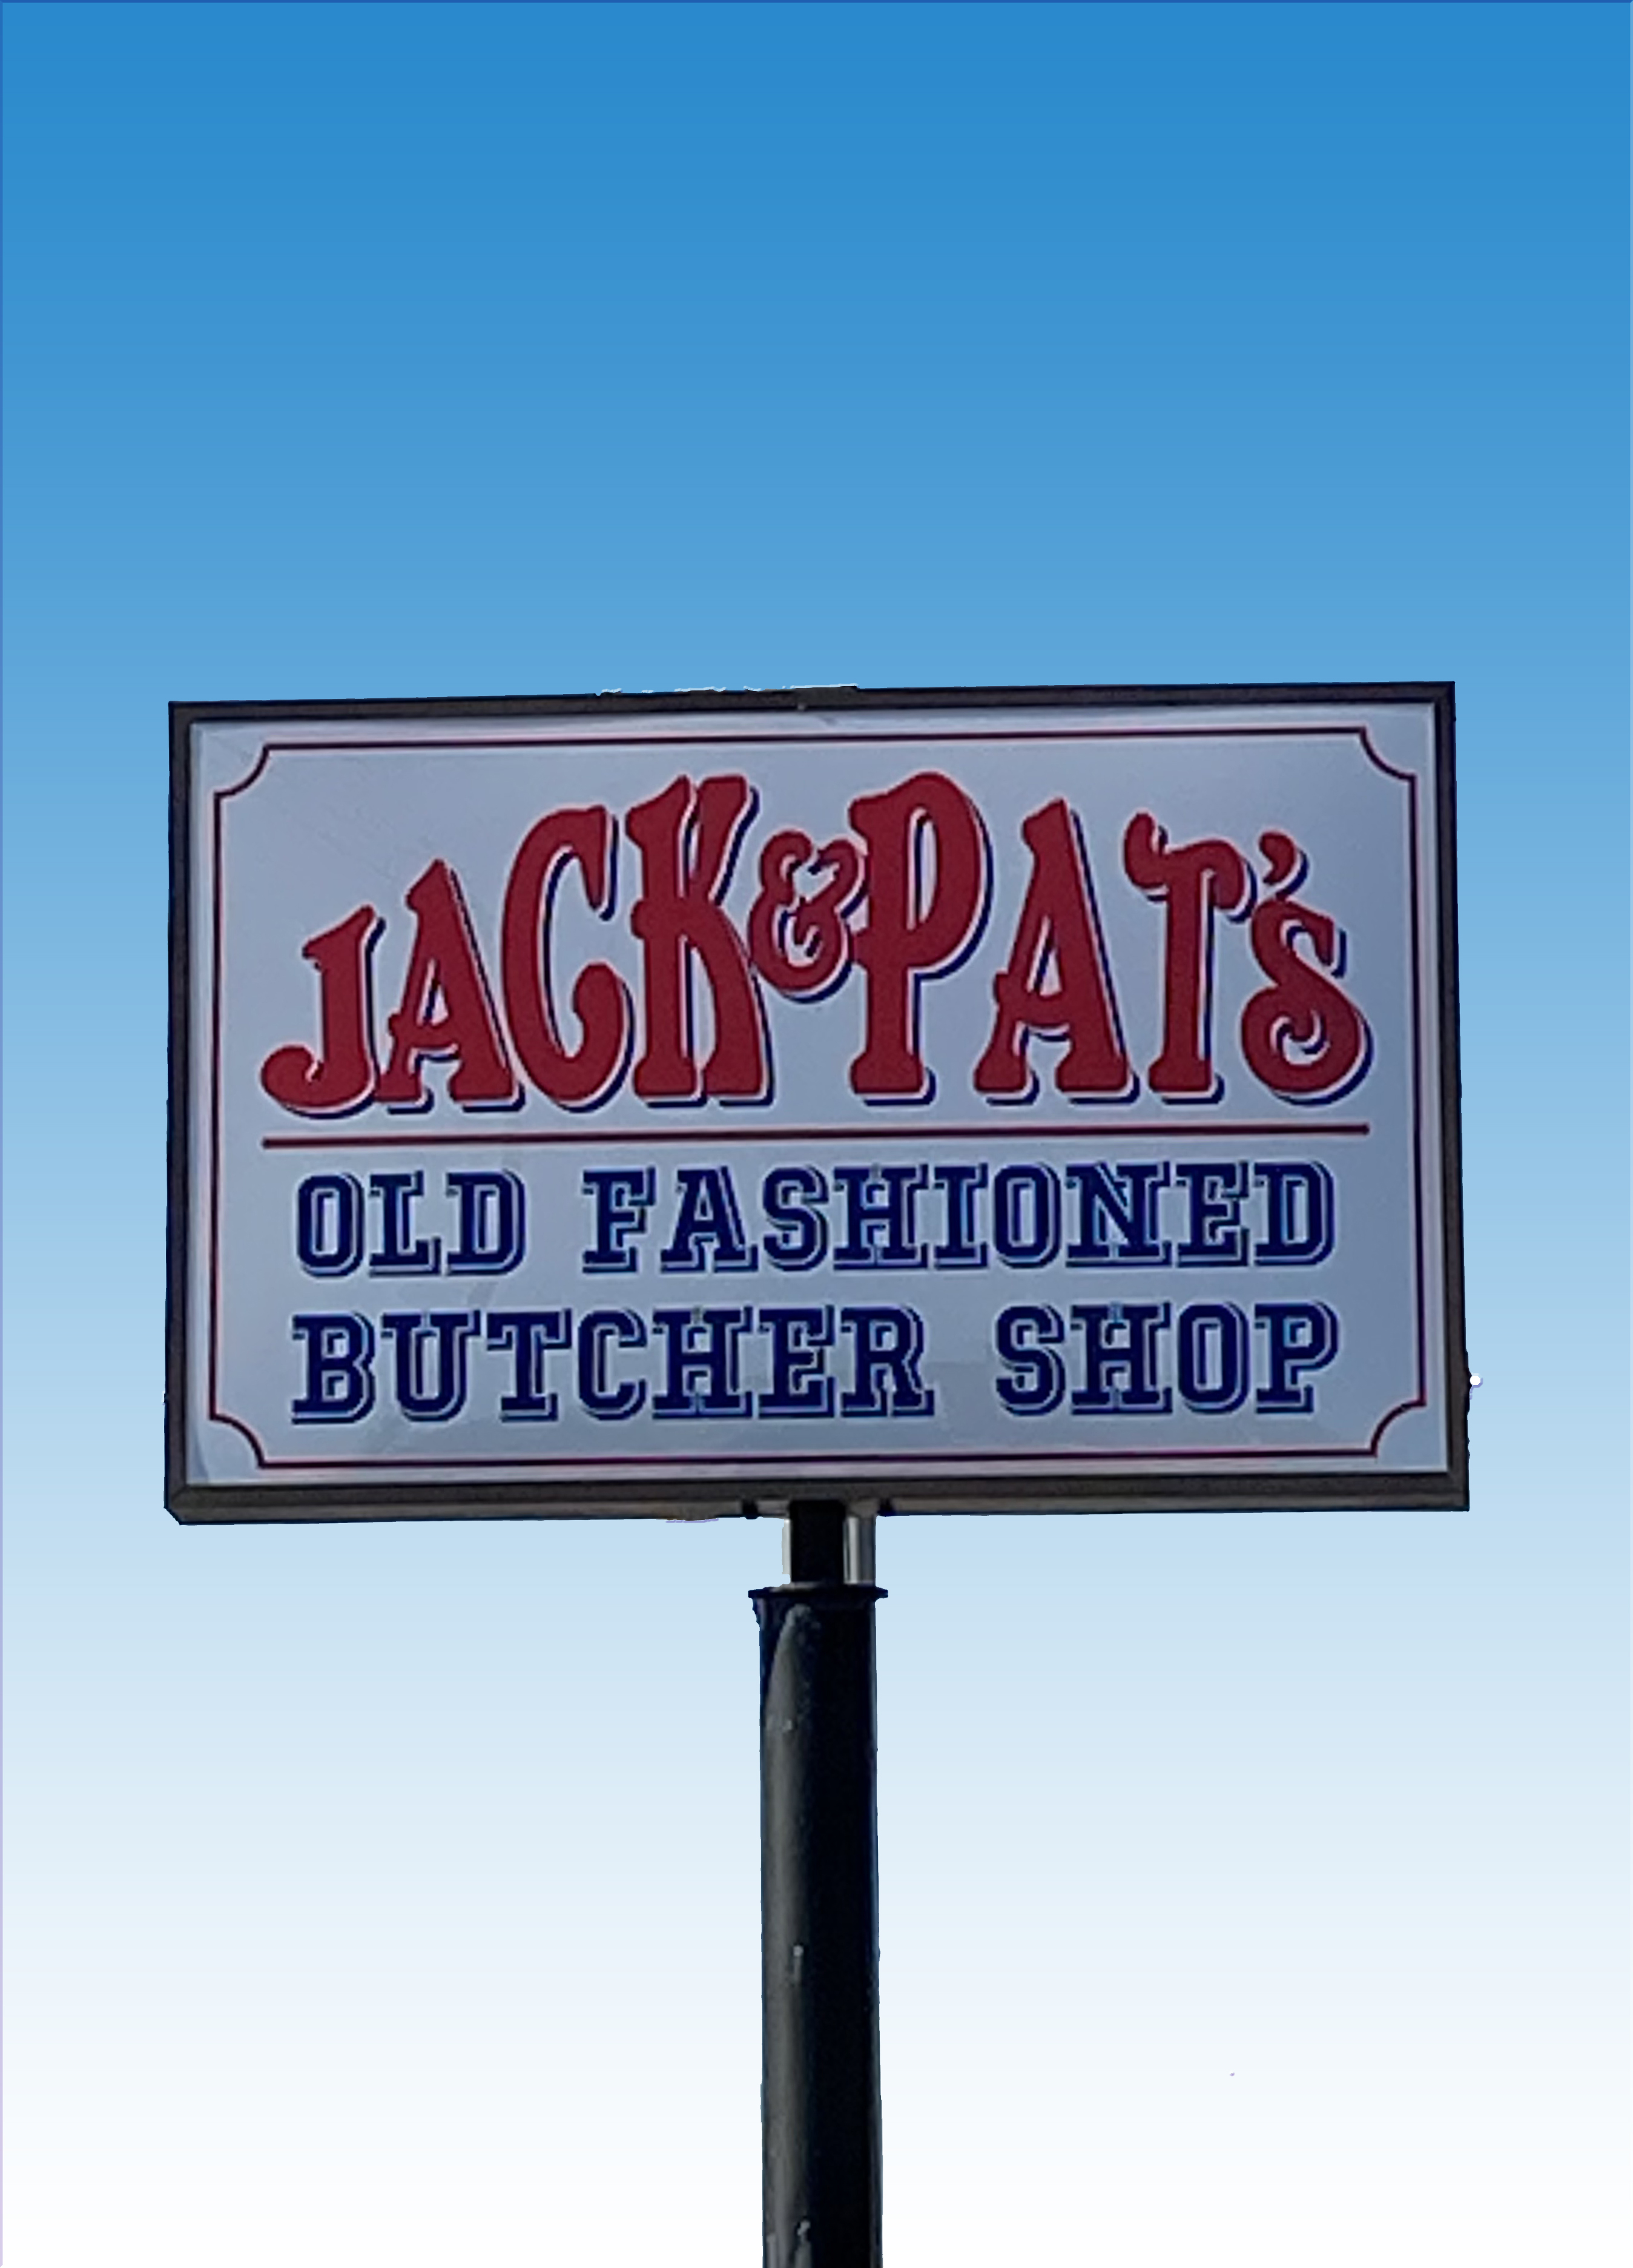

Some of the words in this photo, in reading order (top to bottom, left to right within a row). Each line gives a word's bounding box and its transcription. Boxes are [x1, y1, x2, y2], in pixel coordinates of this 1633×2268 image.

[297, 1169, 526, 1277] OLD
[582, 1161, 1335, 1274] FASHIONED
[292, 1304, 934, 1424] BUTCHER
[995, 1301, 1339, 1417] SHOP
